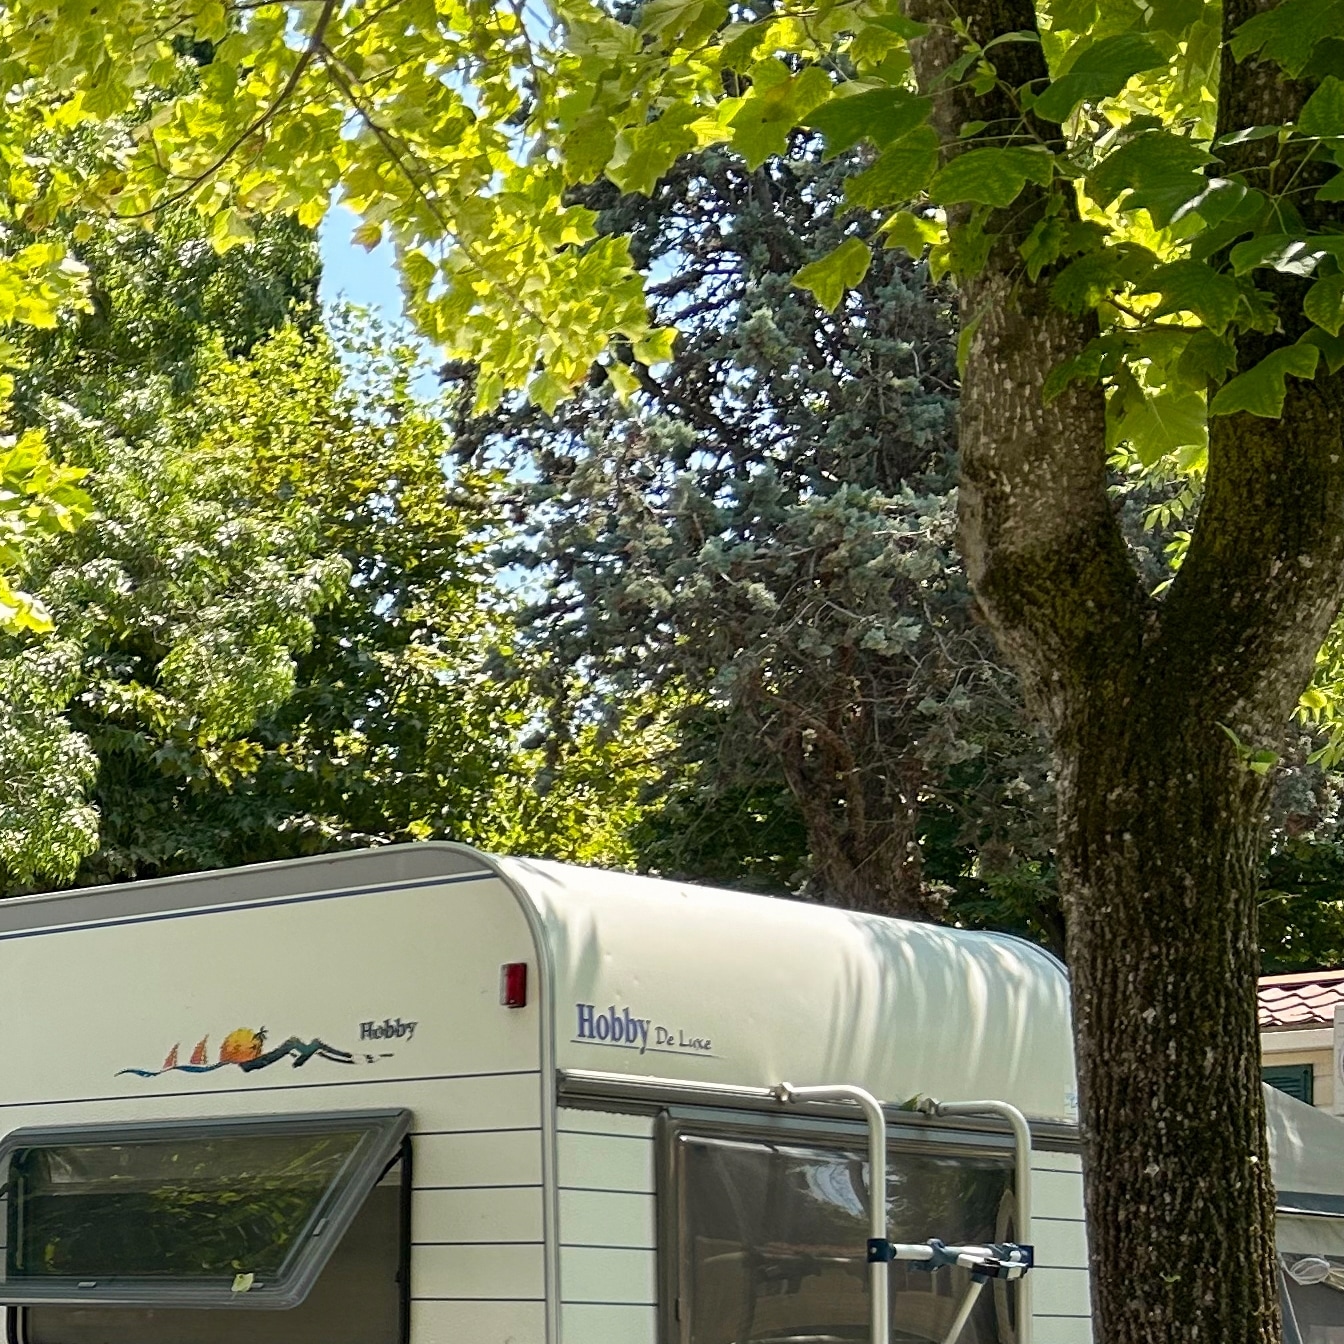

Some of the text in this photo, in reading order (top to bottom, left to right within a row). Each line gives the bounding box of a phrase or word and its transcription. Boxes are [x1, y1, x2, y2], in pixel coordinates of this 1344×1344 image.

[359, 1018, 418, 1042] Hobby
[576, 1003, 712, 1055] Hobby De Luxe
